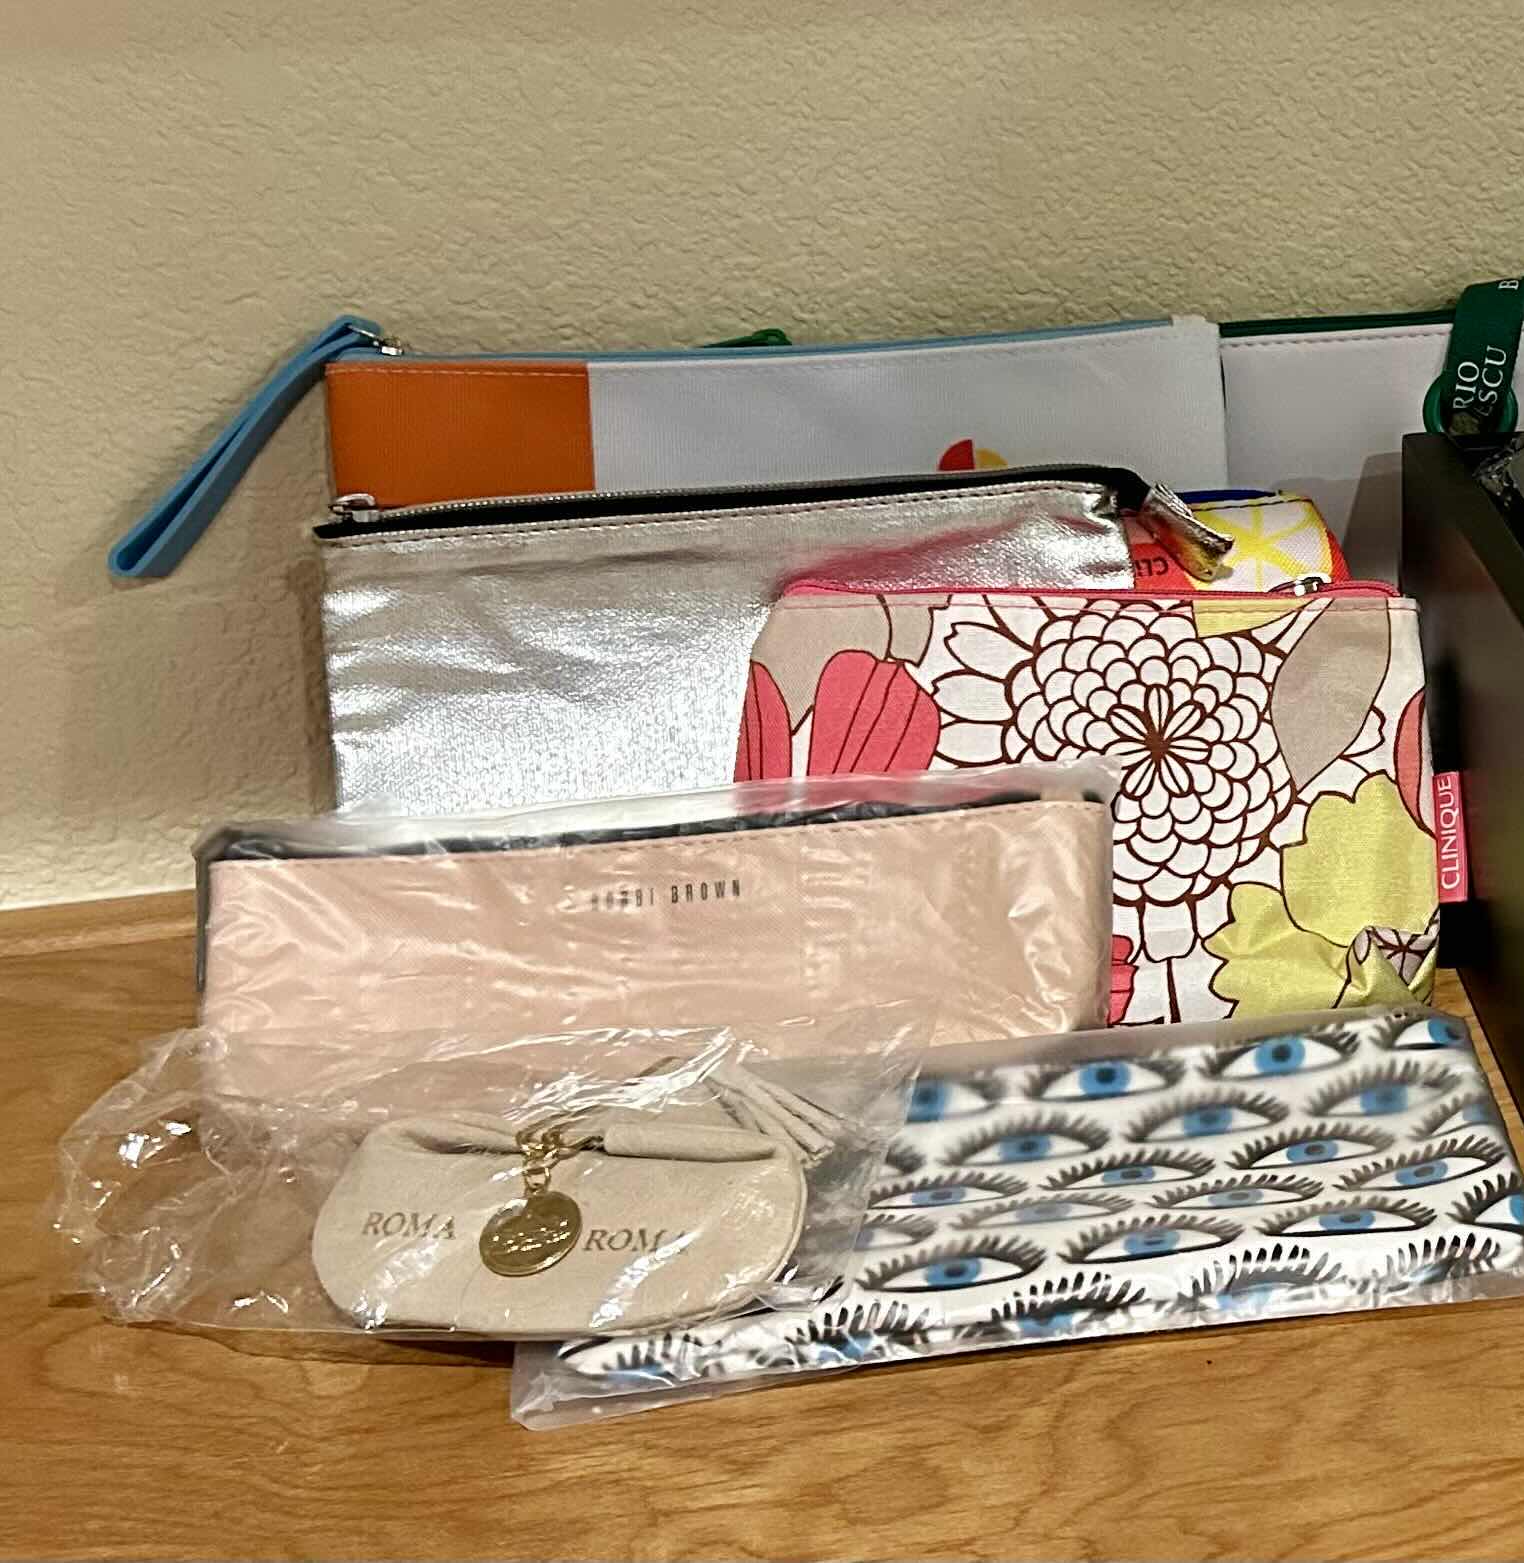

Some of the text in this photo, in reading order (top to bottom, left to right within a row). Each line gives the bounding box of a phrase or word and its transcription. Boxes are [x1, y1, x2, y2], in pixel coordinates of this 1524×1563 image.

[1453, 361, 1480, 409] RIO
[1436, 776, 1461, 890] CLINIQUE
[671, 879, 741, 903] BROWN
[361, 1210, 457, 1240] ROMA
